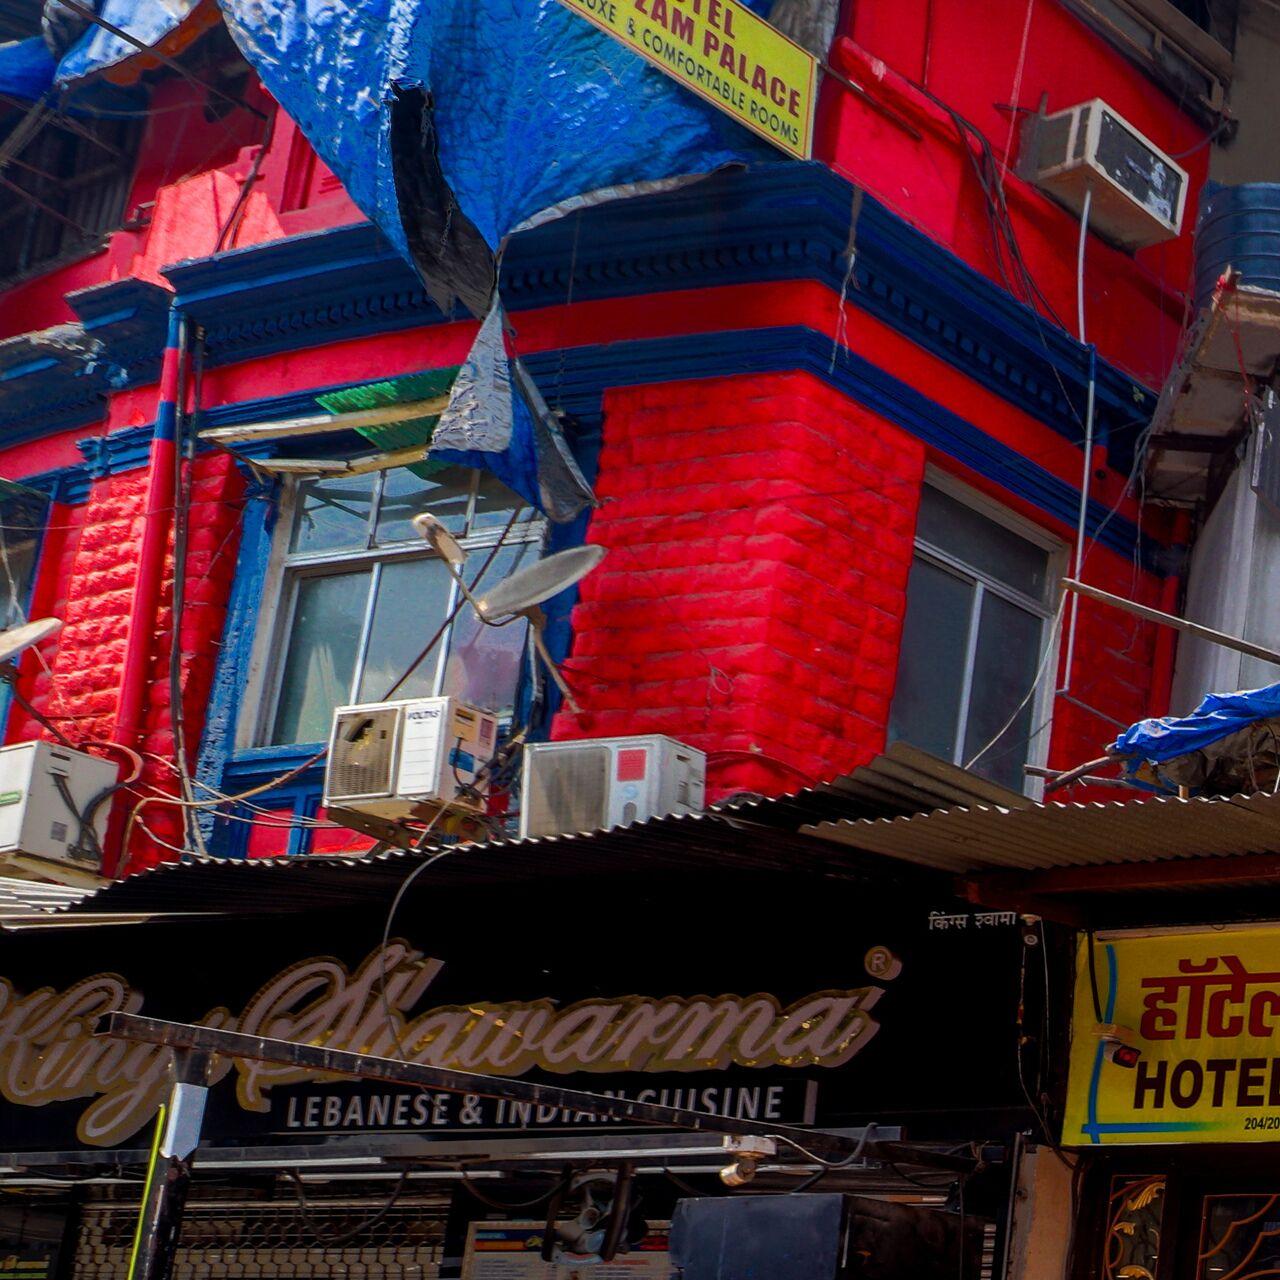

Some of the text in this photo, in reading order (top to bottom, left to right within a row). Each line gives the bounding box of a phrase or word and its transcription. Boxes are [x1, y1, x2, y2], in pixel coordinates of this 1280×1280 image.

[626, 17, 637, 39] &
[642, 28, 746, 111] COMFORTABLE
[750, 102, 800, 146] ROOMS
[703, 29, 801, 118] PALACE
[238, 938, 884, 1112] Shawarma
[287, 1093, 451, 1128] LEBANESE
[459, 1093, 483, 1126] &
[638, 1085, 784, 1120] CUISINE
